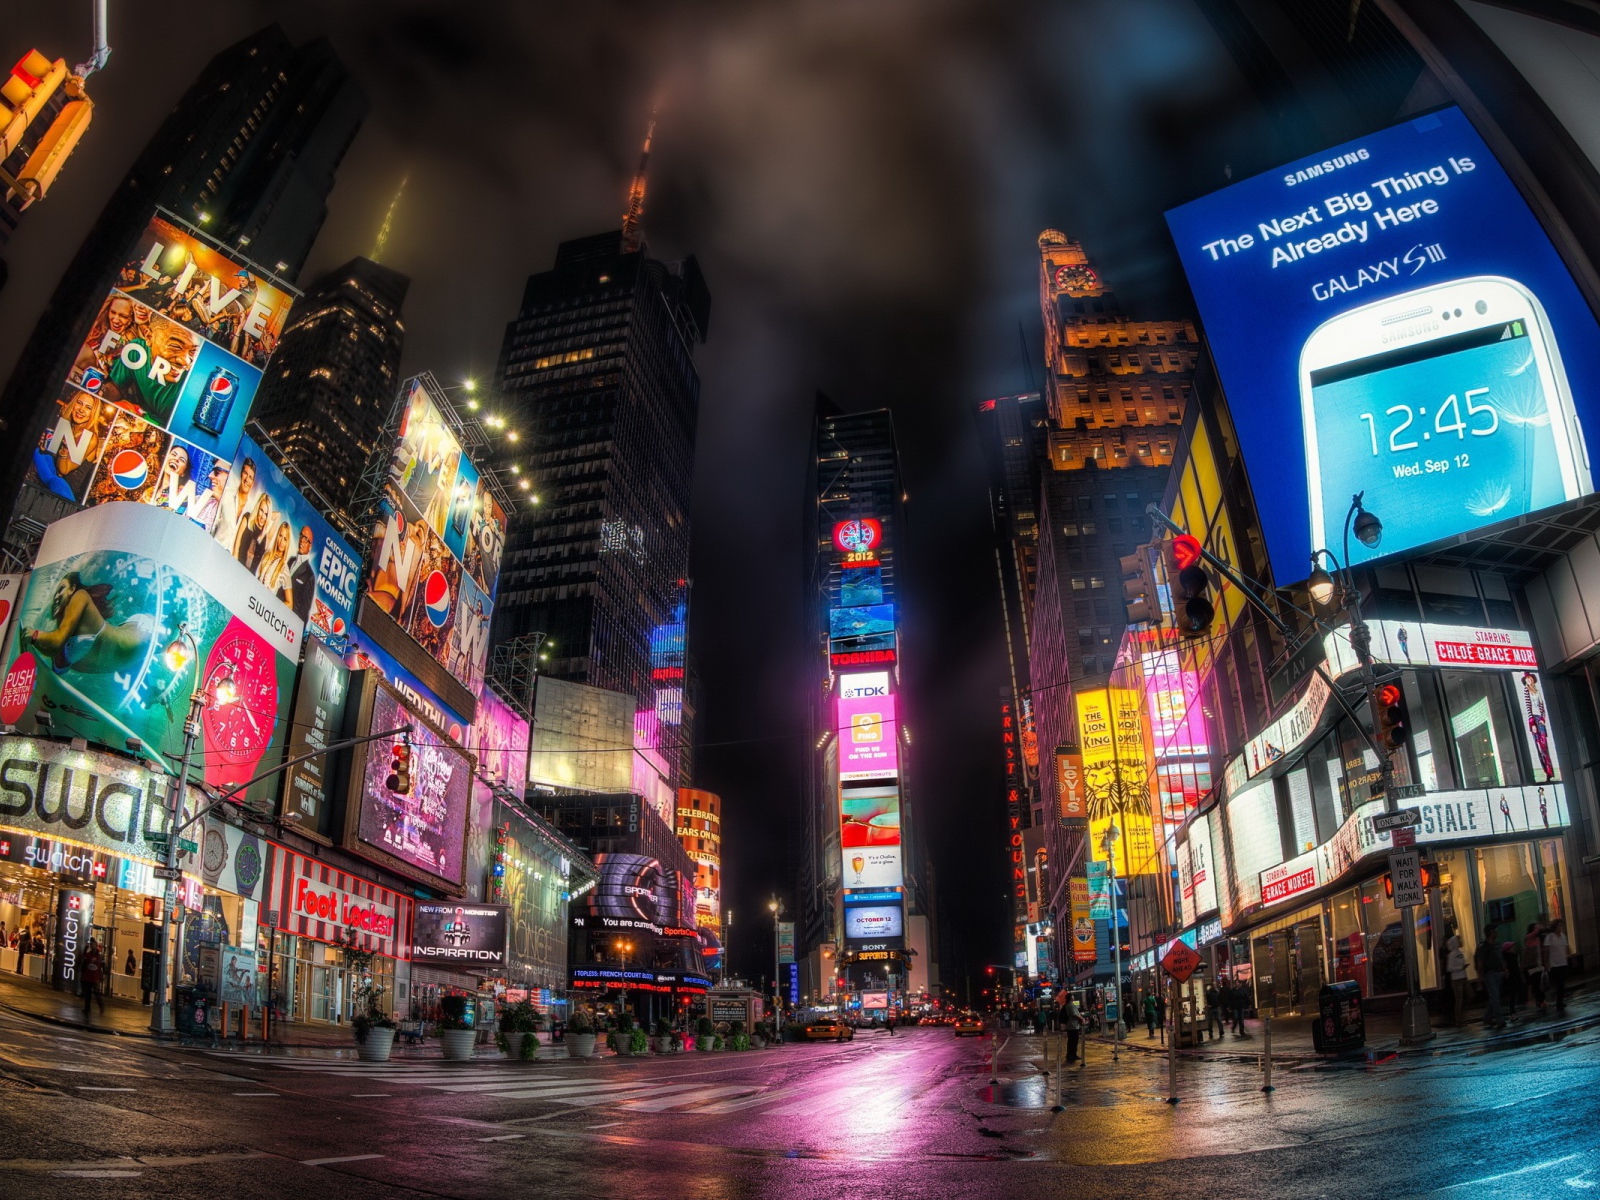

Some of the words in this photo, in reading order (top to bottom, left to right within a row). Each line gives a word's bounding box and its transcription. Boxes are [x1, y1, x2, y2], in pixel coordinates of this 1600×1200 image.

[1284, 148, 1370, 187] SAMSUNG
[1201, 231, 1254, 262] The
[1257, 203, 1323, 241] Next
[1324, 189, 1374, 219] Big
[1371, 165, 1450, 200] Thing
[1448, 156, 1476, 176] Is
[1270, 219, 1370, 268] Already
[1377, 196, 1440, 222] Here
[140, 241, 273, 340] LIVE
[1312, 266, 1401, 312] GALAXY
[1380, 321, 1441, 345] SAMSUNG
[98, 329, 171, 386] FOR
[1358, 385, 1500, 457] 12:45
[1425, 458, 1450, 477] Sep
[1455, 454, 1470, 468] 12
[472, 510, 503, 568] FOR
[326, 536, 344, 558] CATCH
[343, 552, 359, 574] EVERY
[847, 551, 874, 562] 2012
[319, 546, 357, 600] EPIC
[841, 560, 880, 569] TOSHIBA
[316, 573, 353, 612] MOMENT
[248, 596, 288, 640] swatch
[1475, 630, 1511, 645] STARRING
[831, 650, 896, 666] TOSHIBA
[1440, 642, 1473, 661] CHLOË
[1476, 645, 1511, 663] GRACE
[5, 668, 35, 689] PUSH
[1283, 671, 1291, 686] 7
[1293, 656, 1306, 680] AV
[12, 684, 30, 694] BUTTON
[854, 685, 885, 697] TDK
[1, 696, 12, 708] OF
[12, 692, 29, 706] FUN
[1084, 711, 1102, 721] THE
[857, 731, 877, 740] FIND
[1083, 722, 1107, 735] LION
[1002, 705, 1015, 775] ERNST
[1083, 735, 1111, 750] KING
[1062, 759, 1080, 813] Levi's
[1397, 788, 1407, 798] W
[1408, 785, 1419, 798] 45
[1008, 789, 1018, 802] &
[0, 758, 205, 871] swath
[629, 794, 637, 833] 1500
[1380, 817, 1394, 827] ONE
[1399, 813, 1413, 823] WAY
[23, 843, 95, 876] swatch
[1011, 815, 1026, 898] YOUNG
[1395, 857, 1413, 868] WAIT
[1266, 867, 1288, 883] STARRING
[1399, 869, 1415, 879] FOR
[1070, 881, 1089, 892] BUBB
[1266, 878, 1288, 899] GRACE
[1288, 869, 1314, 893] MORETZ
[1397, 880, 1419, 891] WALK
[1397, 892, 1421, 903] SIGNAL
[296, 877, 337, 921] Foot
[341, 900, 395, 938] Locker
[419, 905, 435, 914] NEW
[435, 906, 453, 915] FROM
[464, 908, 499, 917] MONSTER
[602, 917, 619, 927] You
[619, 919, 633, 927] are
[62, 908, 81, 982] swatch
[413, 946, 503, 961] INSPIRATION
[858, 951, 888, 960] SUPPORTS
[599, 970, 622, 978] FRENCH
[1172, 965, 1192, 973] AHEAD
